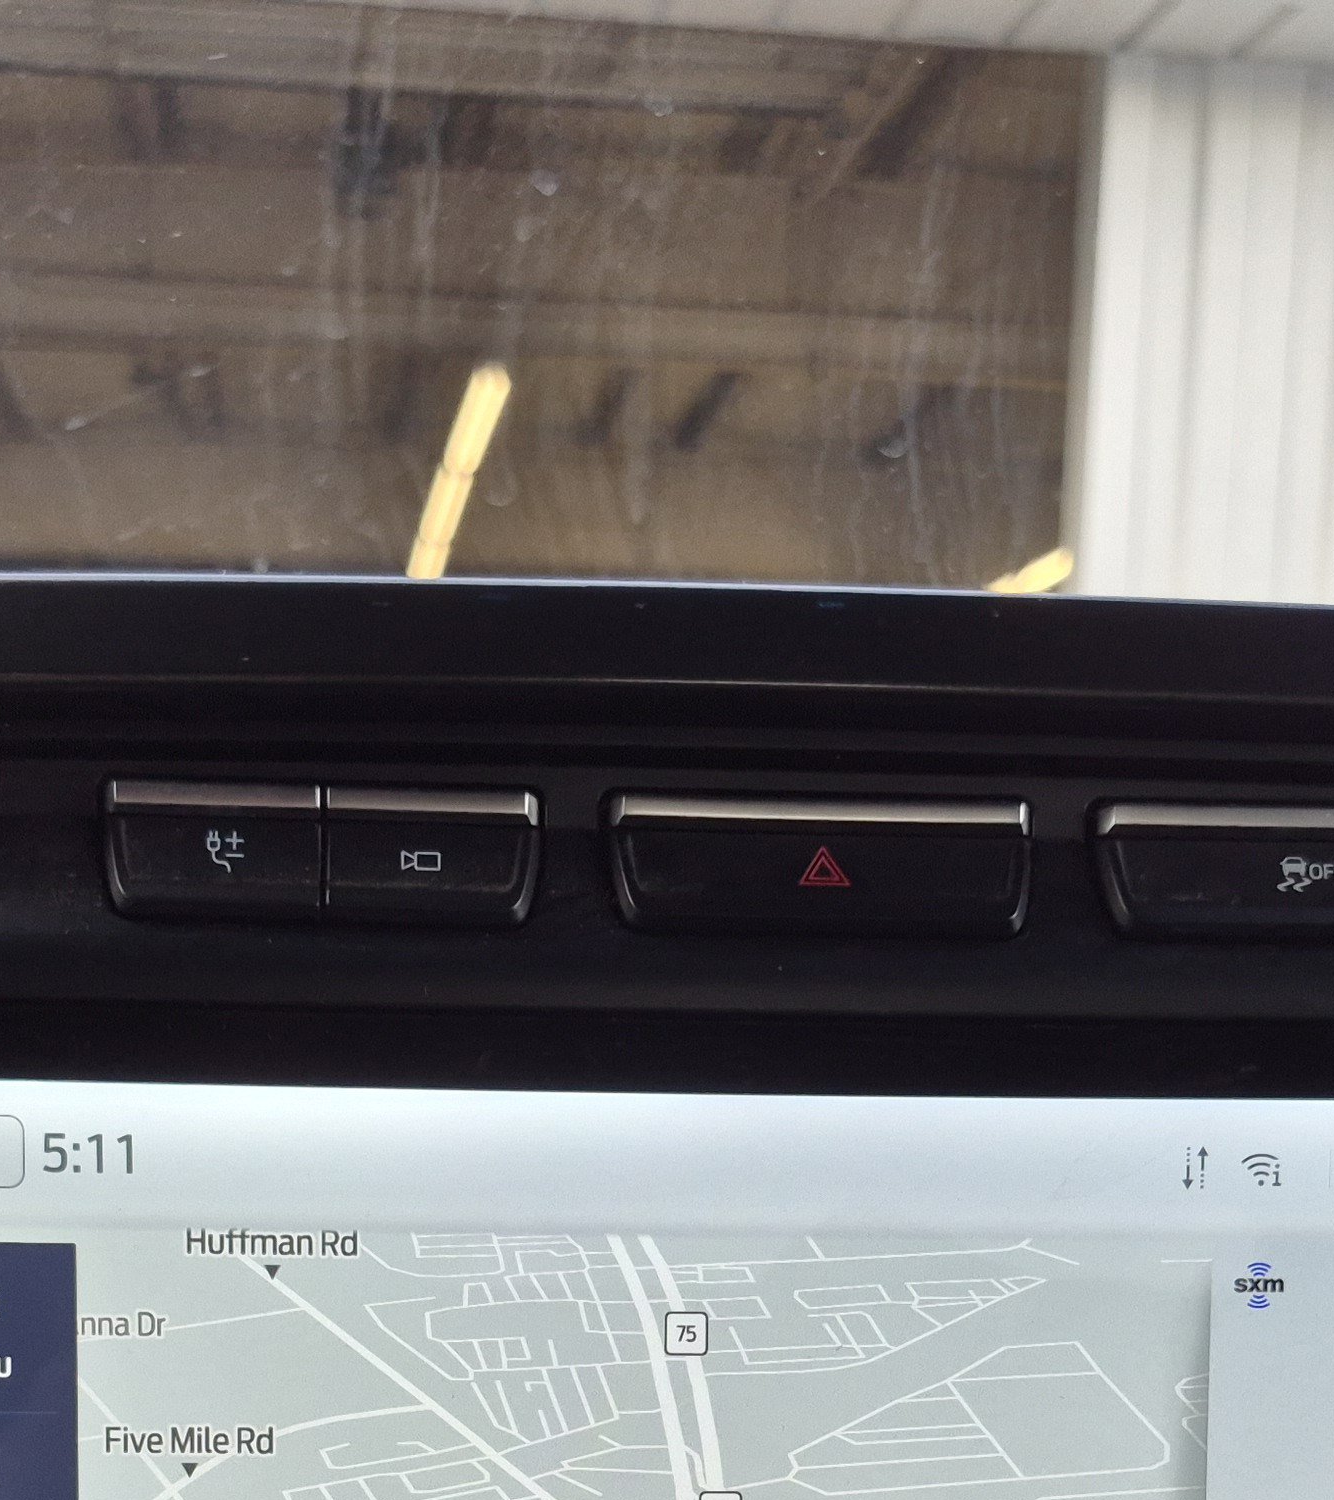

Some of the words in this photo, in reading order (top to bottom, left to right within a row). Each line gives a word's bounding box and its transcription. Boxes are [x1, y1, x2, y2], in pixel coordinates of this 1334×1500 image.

[42, 1133, 137, 1176] 5:11
[185, 1227, 314, 1257] Huffman
[320, 1229, 359, 1257] Rd
[1234, 1278, 1284, 1293] sxm
[77, 1317, 130, 1336] nna
[137, 1311, 166, 1336] Dr
[675, 1324, 697, 1343] 75
[104, 1426, 163, 1455] Five
[170, 1426, 230, 1455] Mile
[238, 1426, 275, 1455] Rd
